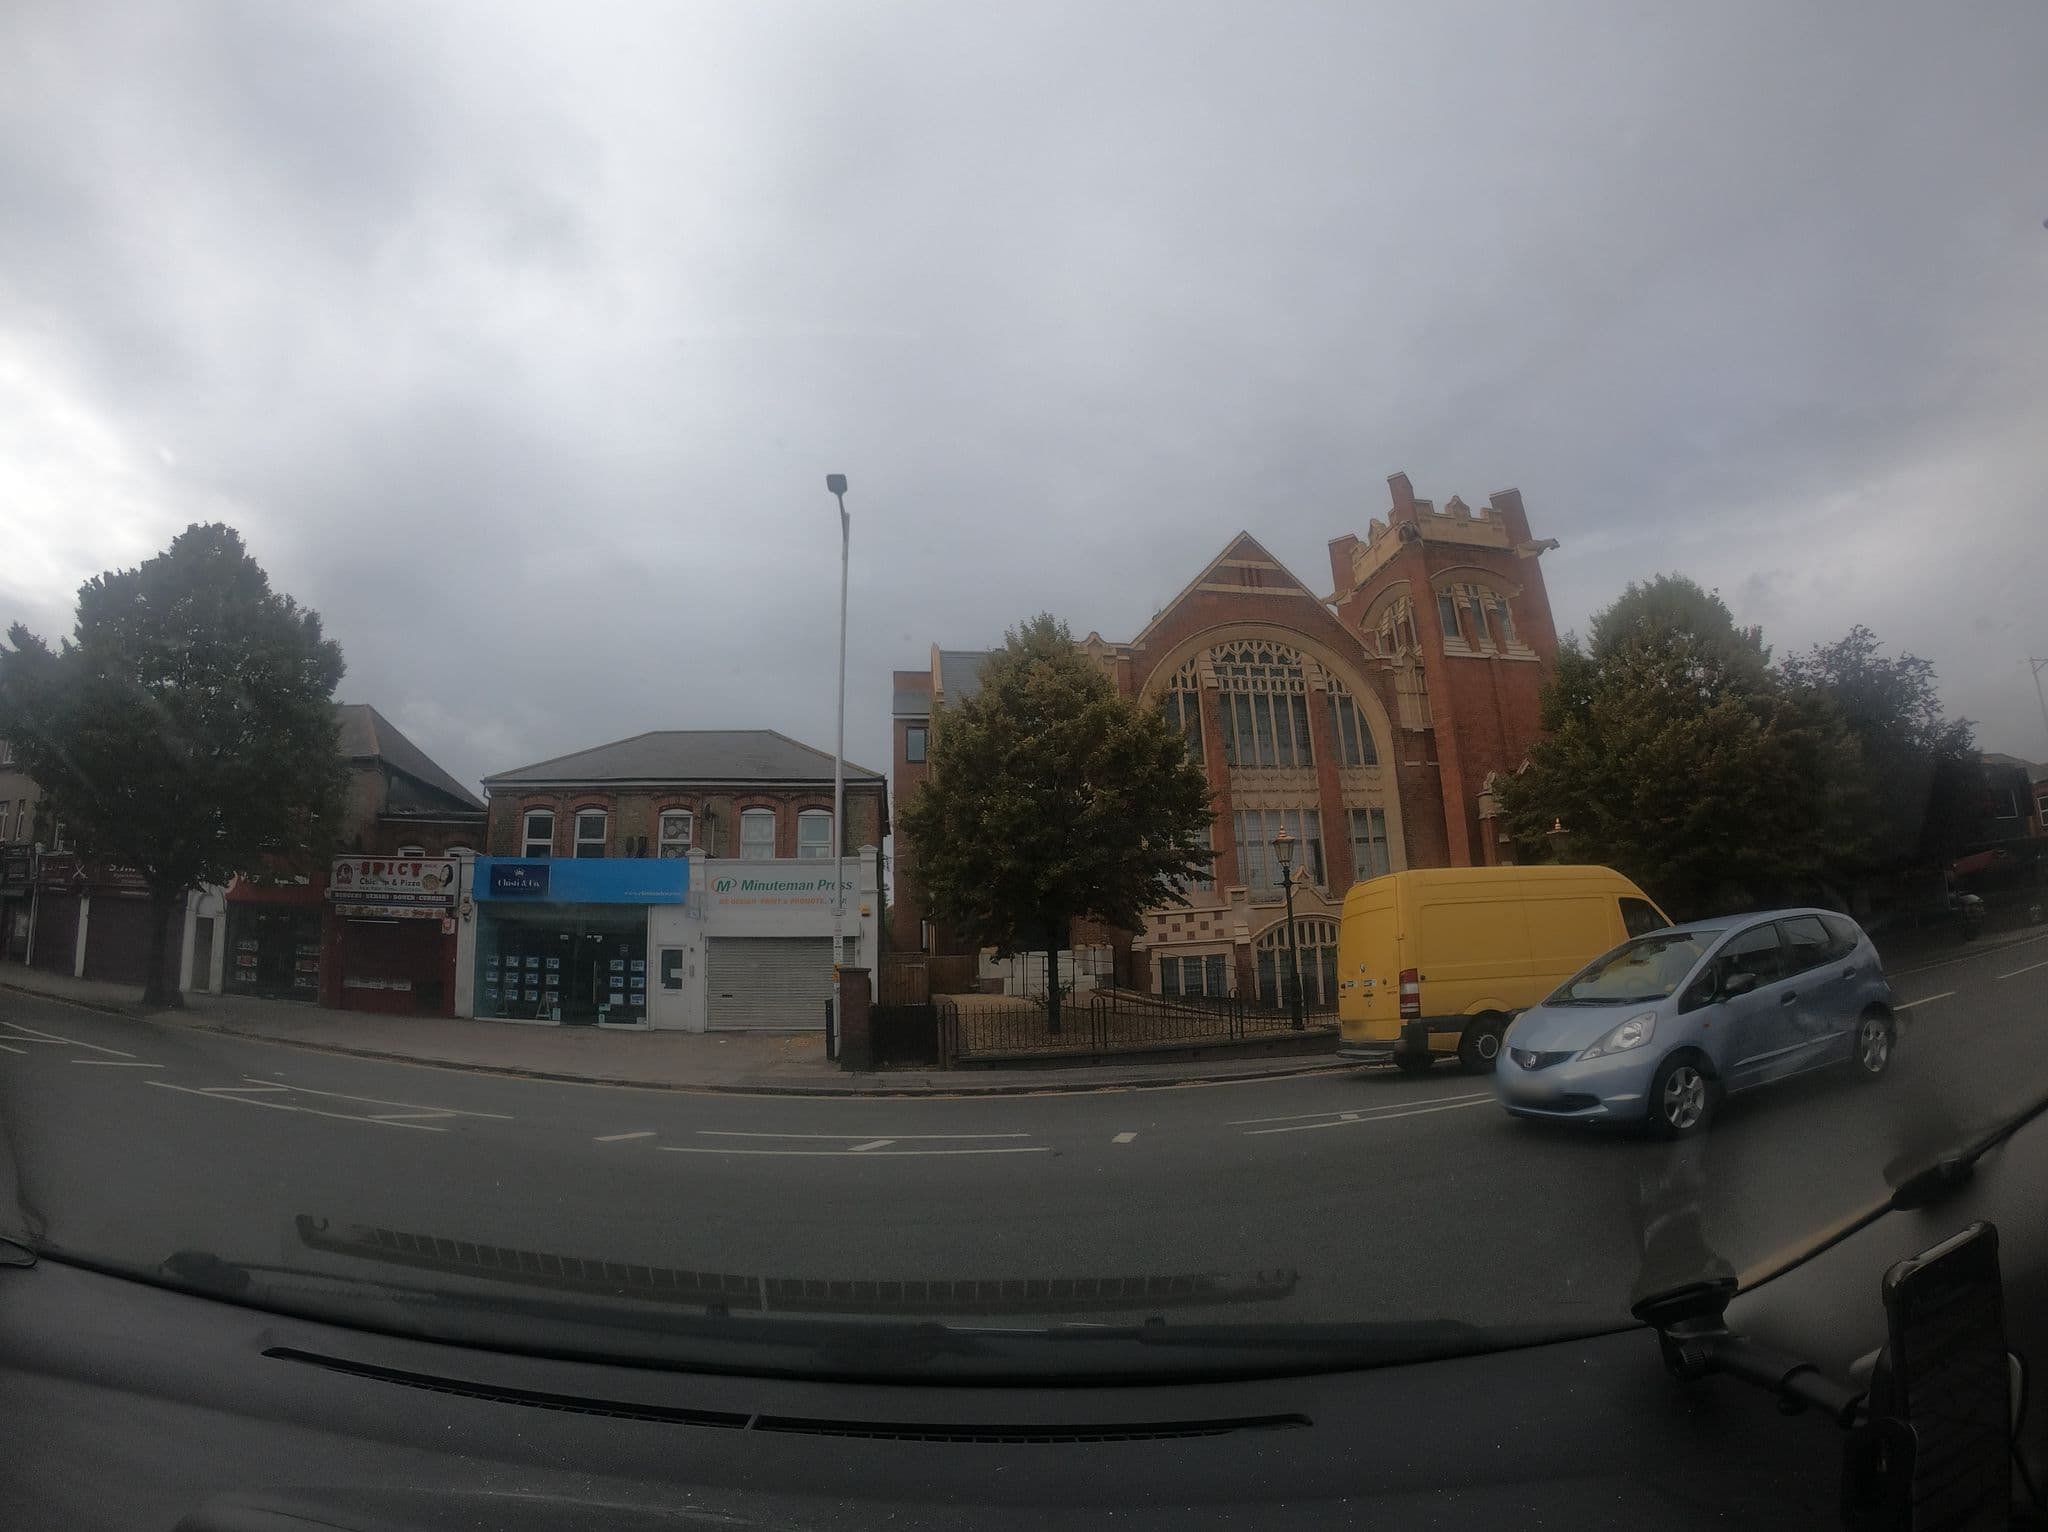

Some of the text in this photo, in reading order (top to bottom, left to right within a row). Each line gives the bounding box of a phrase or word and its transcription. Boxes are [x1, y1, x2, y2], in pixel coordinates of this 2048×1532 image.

[360, 861, 423, 877] SPICY
[359, 877, 390, 886] Chicn
[400, 879, 421, 887] Pizza
[741, 879, 814, 891] Minuteman
